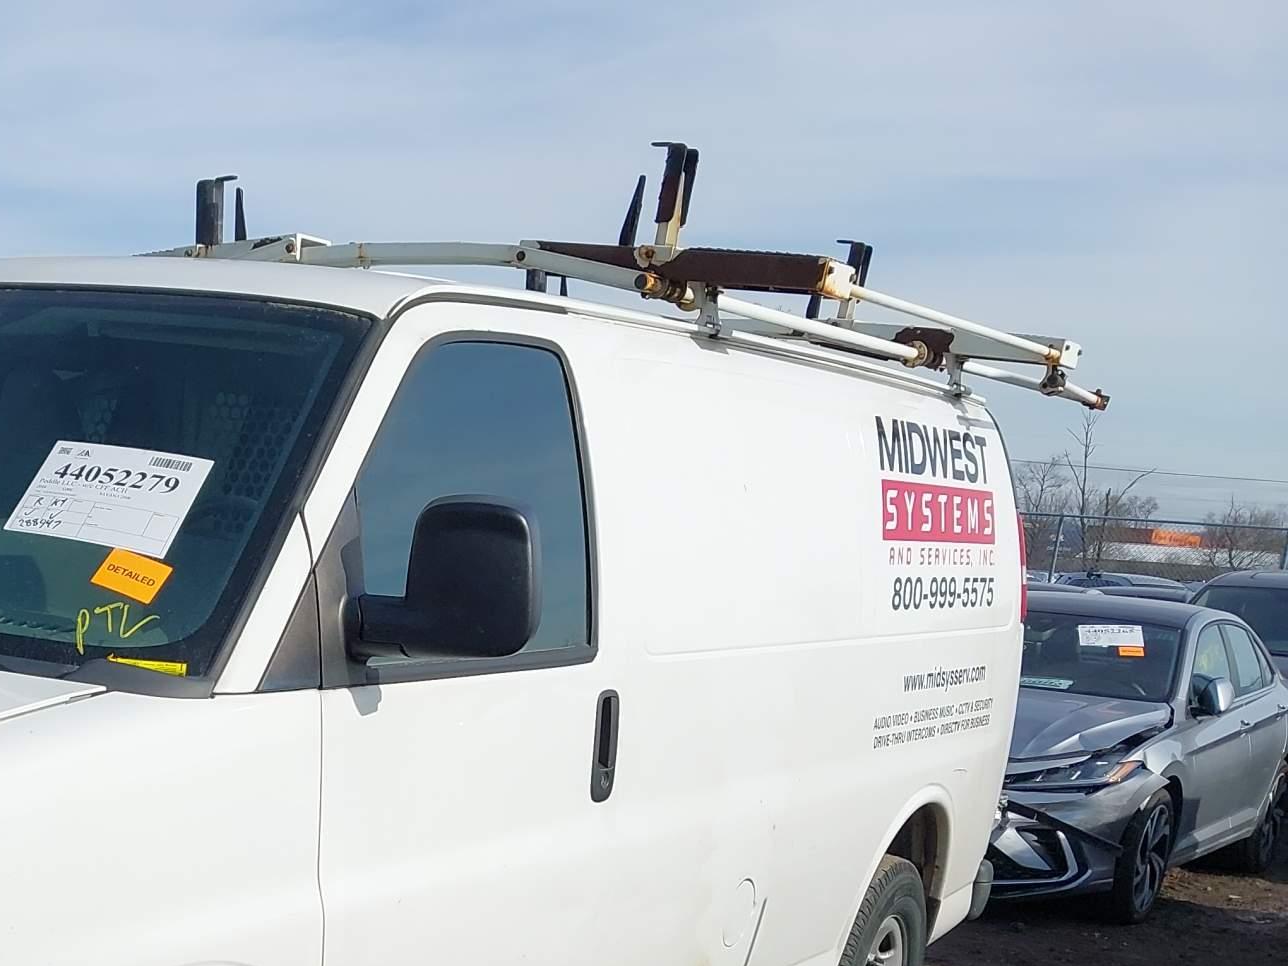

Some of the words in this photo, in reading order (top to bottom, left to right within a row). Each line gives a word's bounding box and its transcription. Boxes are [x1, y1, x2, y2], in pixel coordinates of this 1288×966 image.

[875, 415, 987, 484] MIDWEST
[54, 462, 180, 494] 44052279
[885, 489, 993, 535] SYSTEMS
[889, 547, 912, 565] AND
[106, 563, 155, 587] DETAILED
[892, 576, 995, 610] 800-999-5575
[903, 666, 986, 692] www.midsysserv.com
